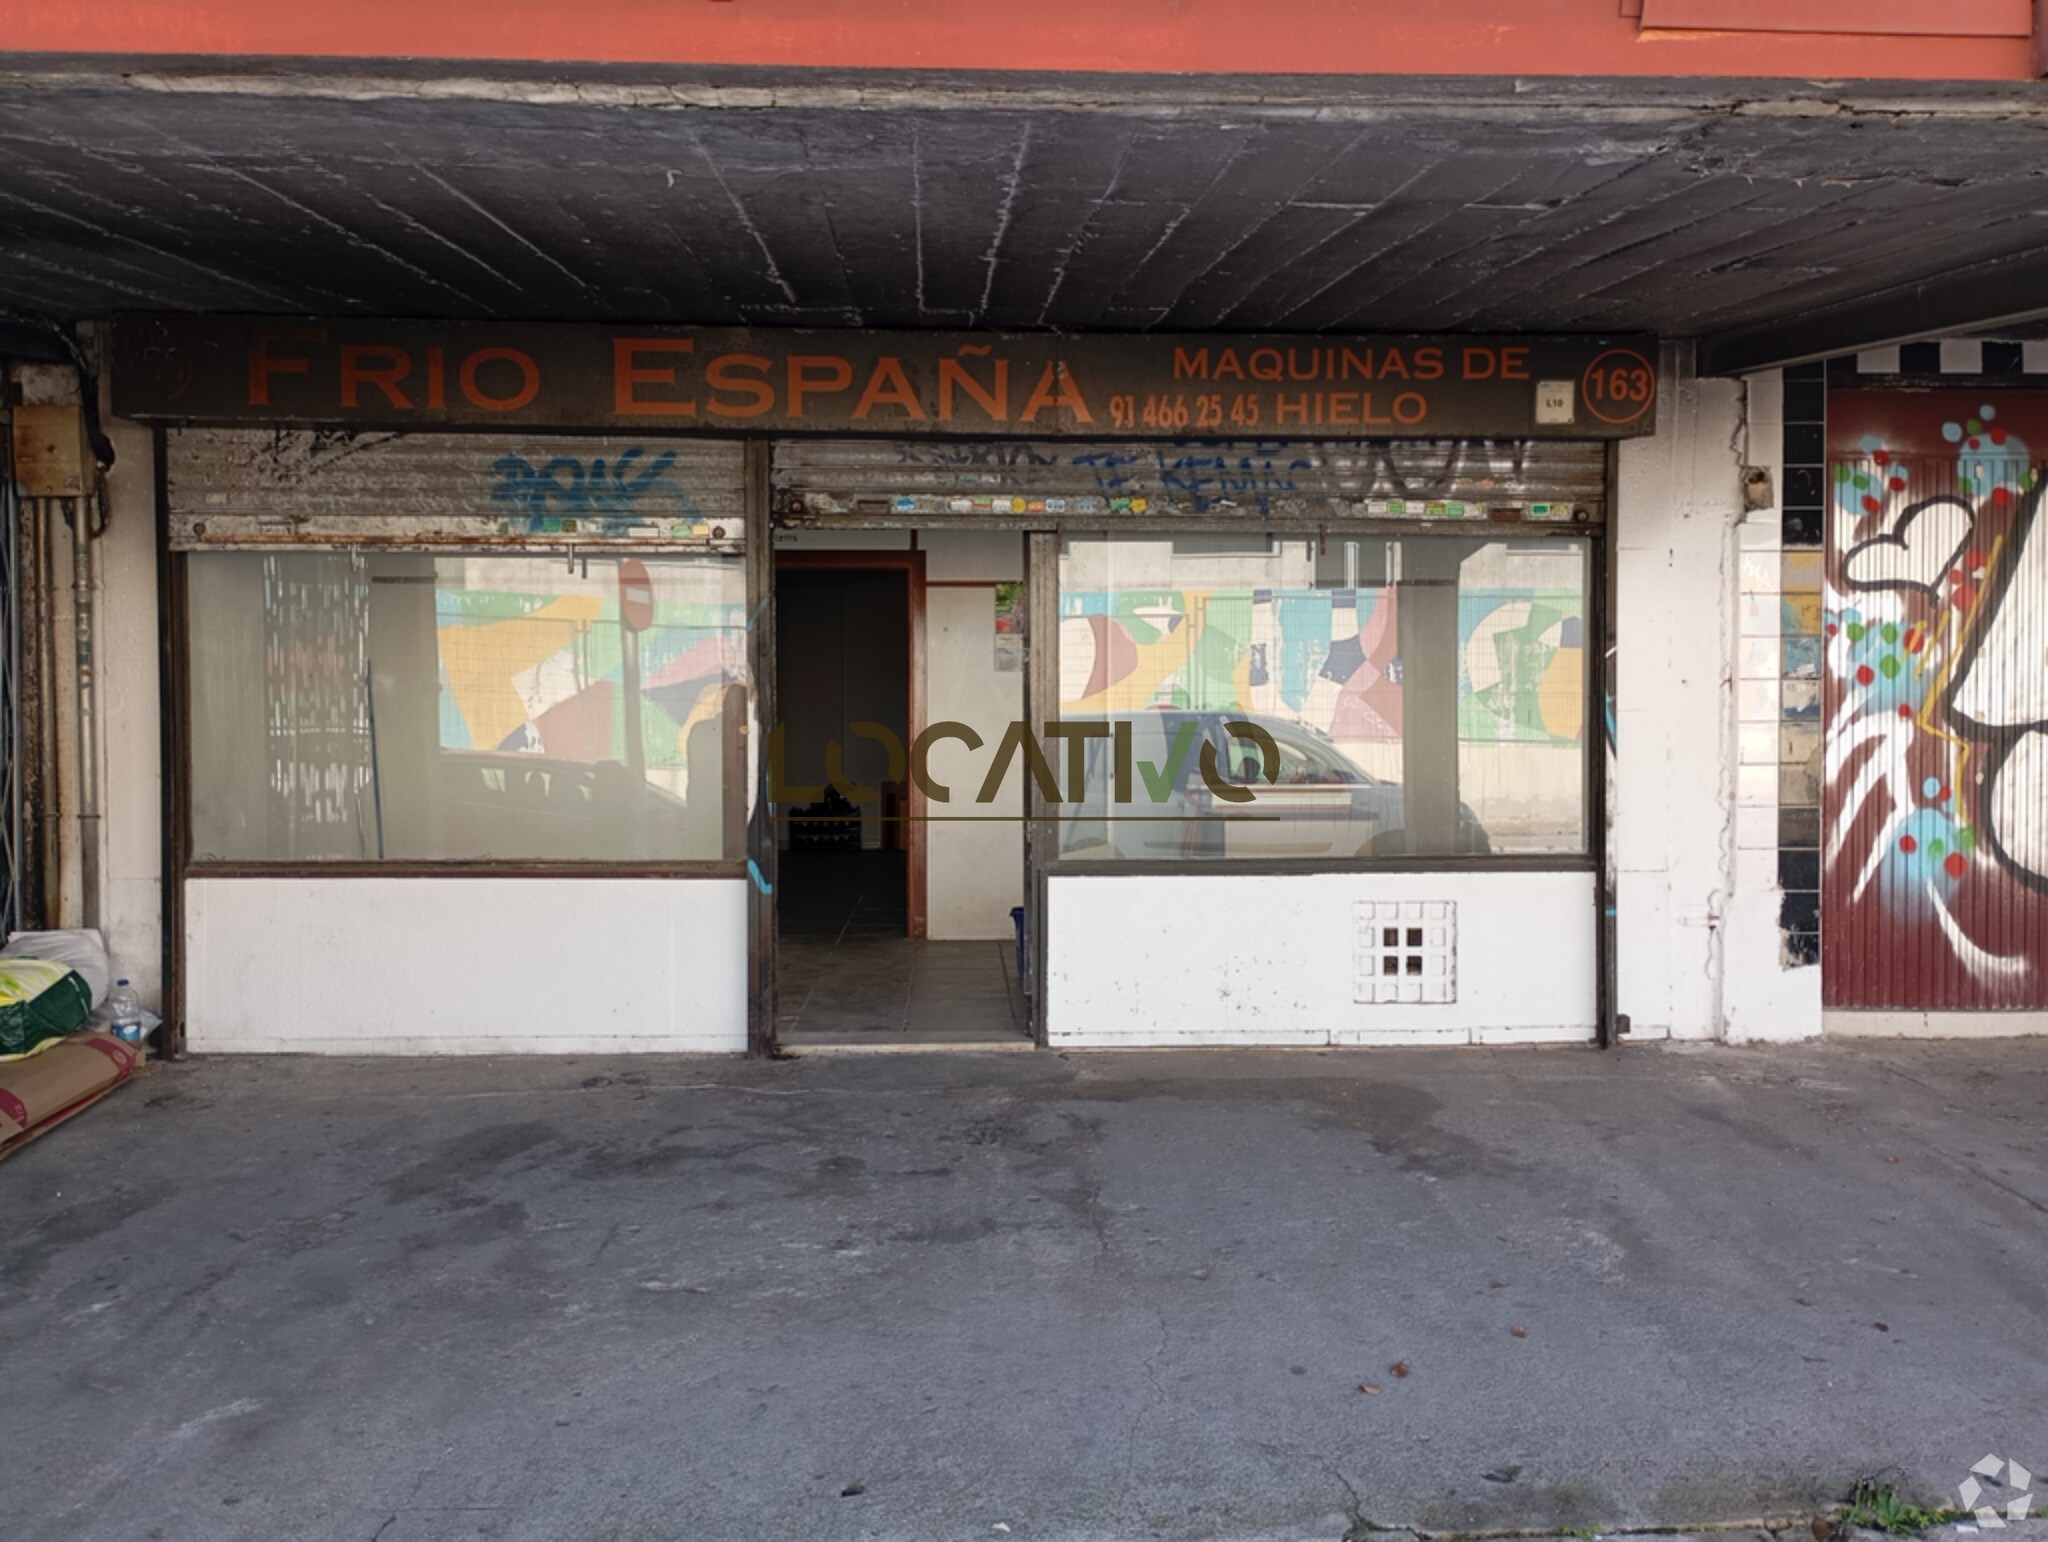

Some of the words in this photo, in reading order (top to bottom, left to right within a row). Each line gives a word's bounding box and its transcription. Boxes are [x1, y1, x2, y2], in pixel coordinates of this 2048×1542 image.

[246, 330, 541, 411] FRIO
[612, 337, 1094, 423] ESPAÑA
[1173, 346, 1445, 386] MAQUINAS
[1462, 347, 1531, 381] DE
[1591, 367, 1649, 401] 163
[1109, 397, 1135, 429] 91
[1143, 394, 1189, 428] 466
[1197, 393, 1223, 428] 25
[1231, 392, 1260, 427] 45
[1274, 390, 1430, 428] HIELO
